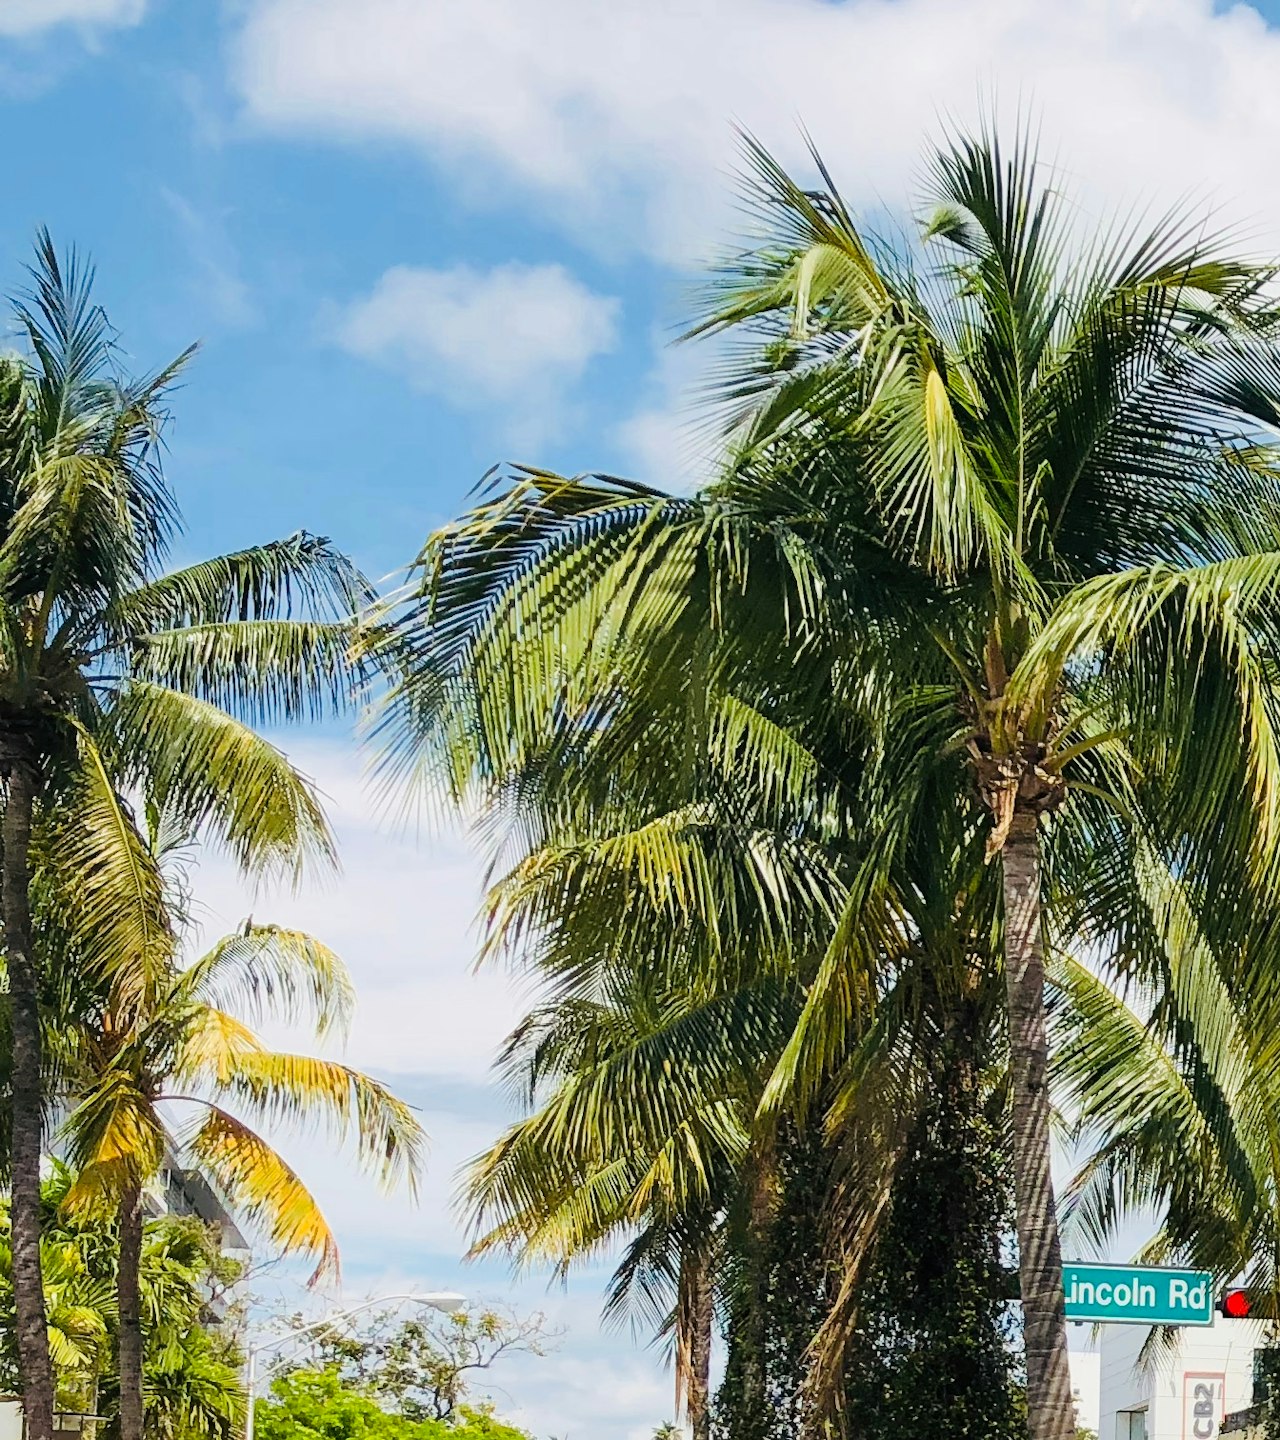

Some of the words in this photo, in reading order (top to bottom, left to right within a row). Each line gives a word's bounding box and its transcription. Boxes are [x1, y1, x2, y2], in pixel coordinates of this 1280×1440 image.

[1064, 1274, 1156, 1308] incoln
[1168, 1278, 1207, 1310] Rd
[1193, 1383, 1214, 1440] CB2
